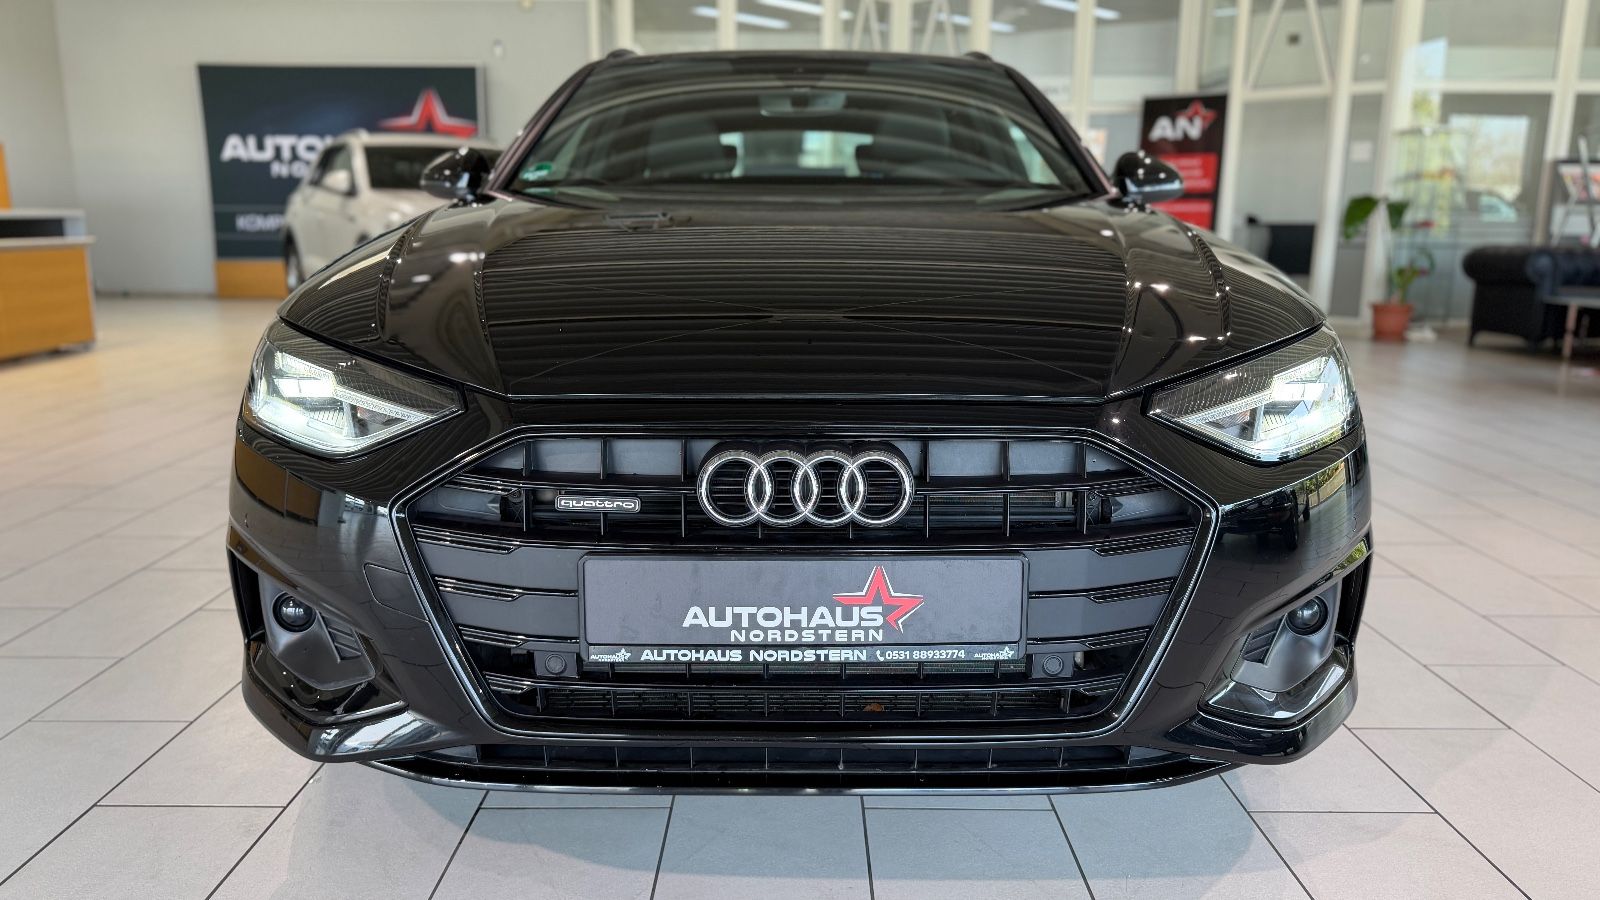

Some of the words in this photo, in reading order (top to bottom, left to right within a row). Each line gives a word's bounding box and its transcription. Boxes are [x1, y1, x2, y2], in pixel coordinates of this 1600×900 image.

[1149, 115, 1203, 141] AN
[220, 134, 333, 162] AUTO
[561, 500, 635, 508] quattro
[682, 606, 884, 627] AUTOHAUS
[730, 629, 883, 642] NORDSTERN
[640, 649, 743, 661] AUTOHAUS
[749, 649, 867, 662] NORDSTERN
[886, 650, 910, 660] 0531
[912, 649, 966, 659] 88933774
